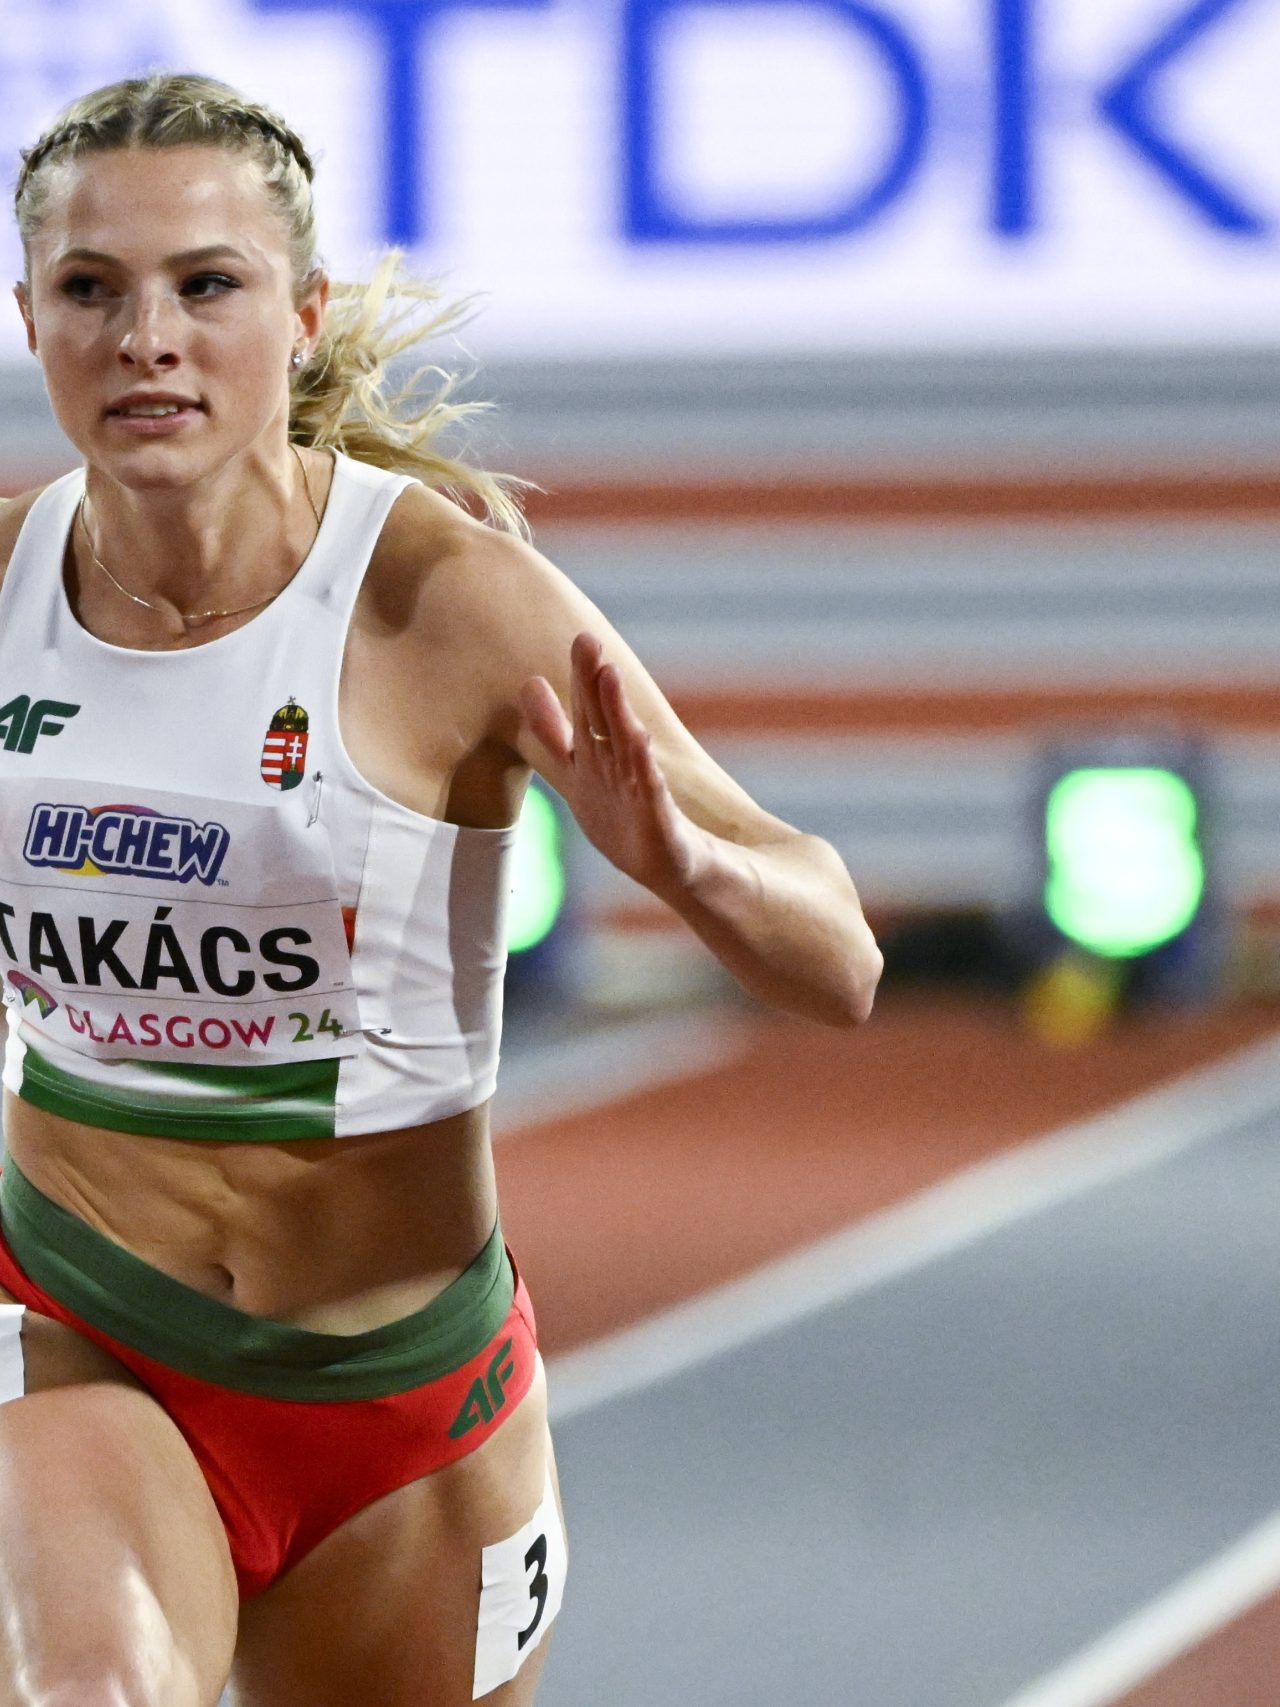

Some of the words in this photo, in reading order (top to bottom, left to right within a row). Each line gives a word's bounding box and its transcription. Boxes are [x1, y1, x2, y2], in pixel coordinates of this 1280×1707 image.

[250, 0, 1270, 246] TDK
[24, 803, 230, 886] HI-CHEW
[64, 1003, 276, 1049] GLASGOW
[287, 1008, 343, 1043] 24
[448, 1337, 515, 1440] 4F
[517, 1533, 549, 1651] 3
